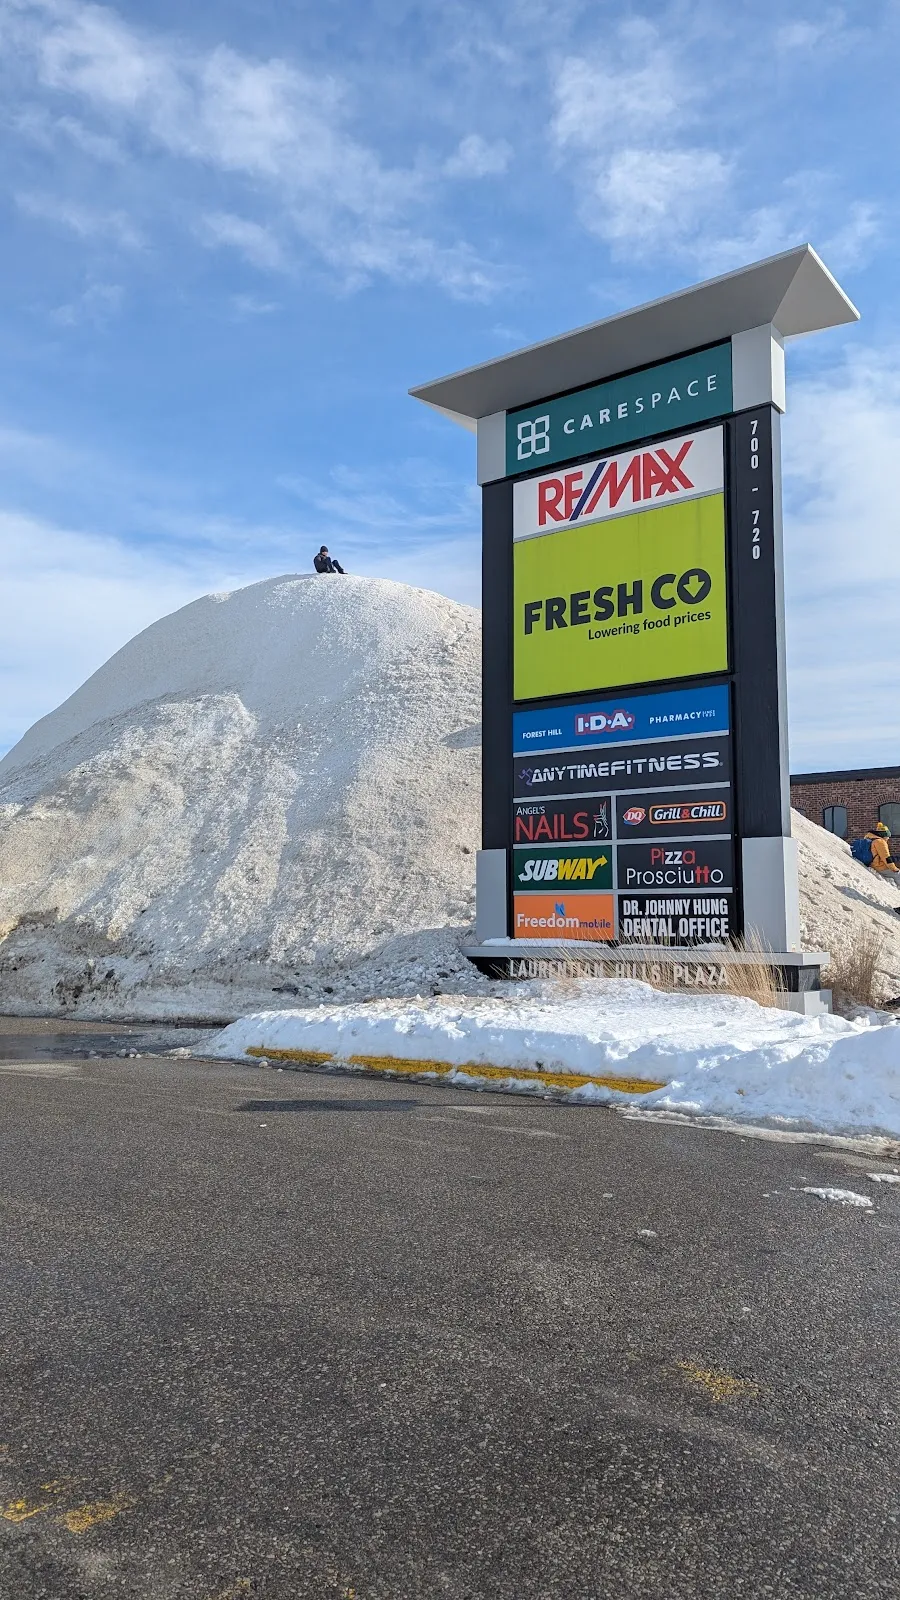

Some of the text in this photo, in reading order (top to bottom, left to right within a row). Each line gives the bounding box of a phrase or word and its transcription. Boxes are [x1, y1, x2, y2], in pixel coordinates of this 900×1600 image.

[563, 374, 718, 434] CARESPACE
[538, 439, 695, 526] RE/MAX
[588, 610, 711, 640] Lowering food prices
[522, 730, 546, 739] FOREST
[548, 728, 562, 737] HILL
[649, 711, 701, 724] PHARMACY
[516, 805, 546, 816] ANGEL'S
[626, 811, 643, 821] DQ
[515, 812, 589, 841] NAILS
[651, 848, 696, 866] Pizza
[518, 855, 608, 882] SUBWAY
[626, 866, 724, 885] Prosciutto
[623, 898, 729, 916] DR. JOHNNY HUNG
[623, 917, 730, 938] DENTAL OFFICE
[673, 965, 729, 986] PLAZA
